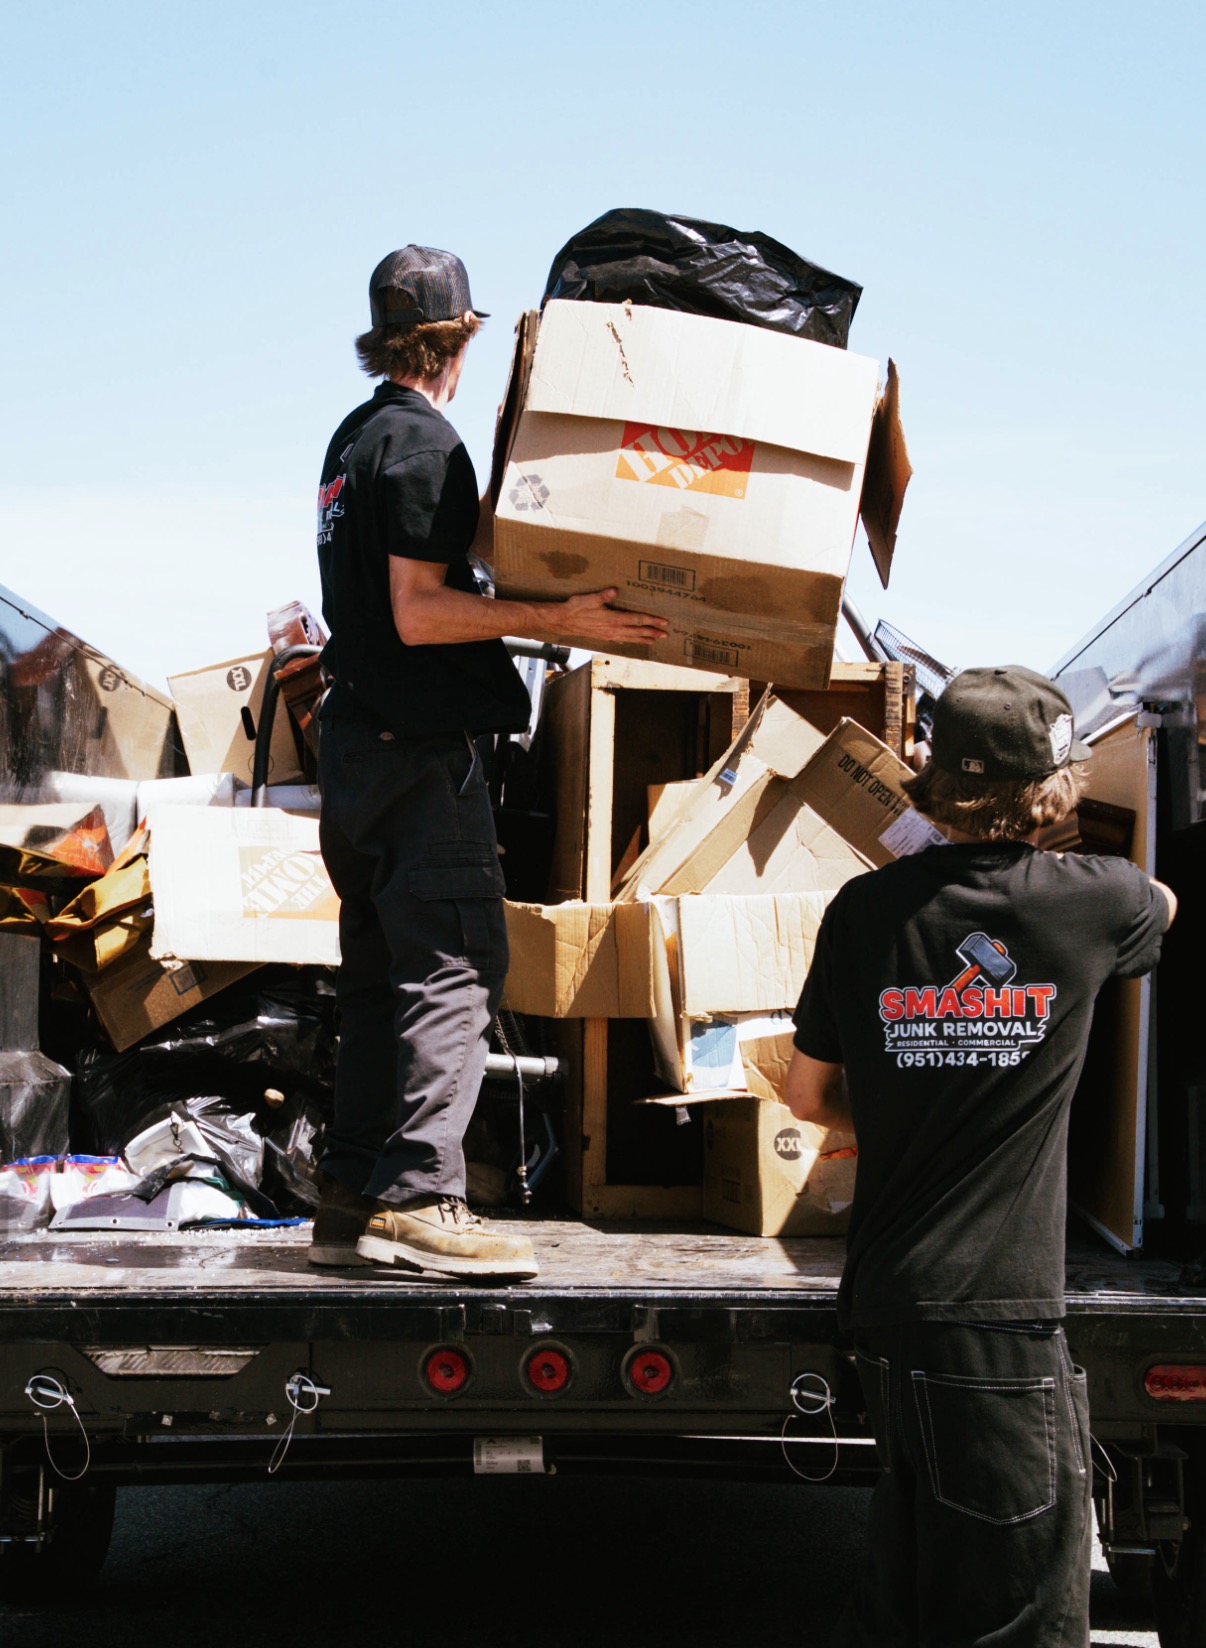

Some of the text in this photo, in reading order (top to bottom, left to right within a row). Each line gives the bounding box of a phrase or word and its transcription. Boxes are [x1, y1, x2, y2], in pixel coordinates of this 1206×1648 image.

[668, 436, 755, 489] DEPO
[231, 667, 247, 691] XXL
[838, 754, 856, 773] DO
[850, 765, 873, 787] NOT
[868, 780, 896, 807] OPEN
[881, 986, 1054, 1021] SMASHIT
[890, 1021, 1038, 1038] JUNK REMOVAL
[896, 1039, 1016, 1048] RESIDENTIAL COMMERCIAL
